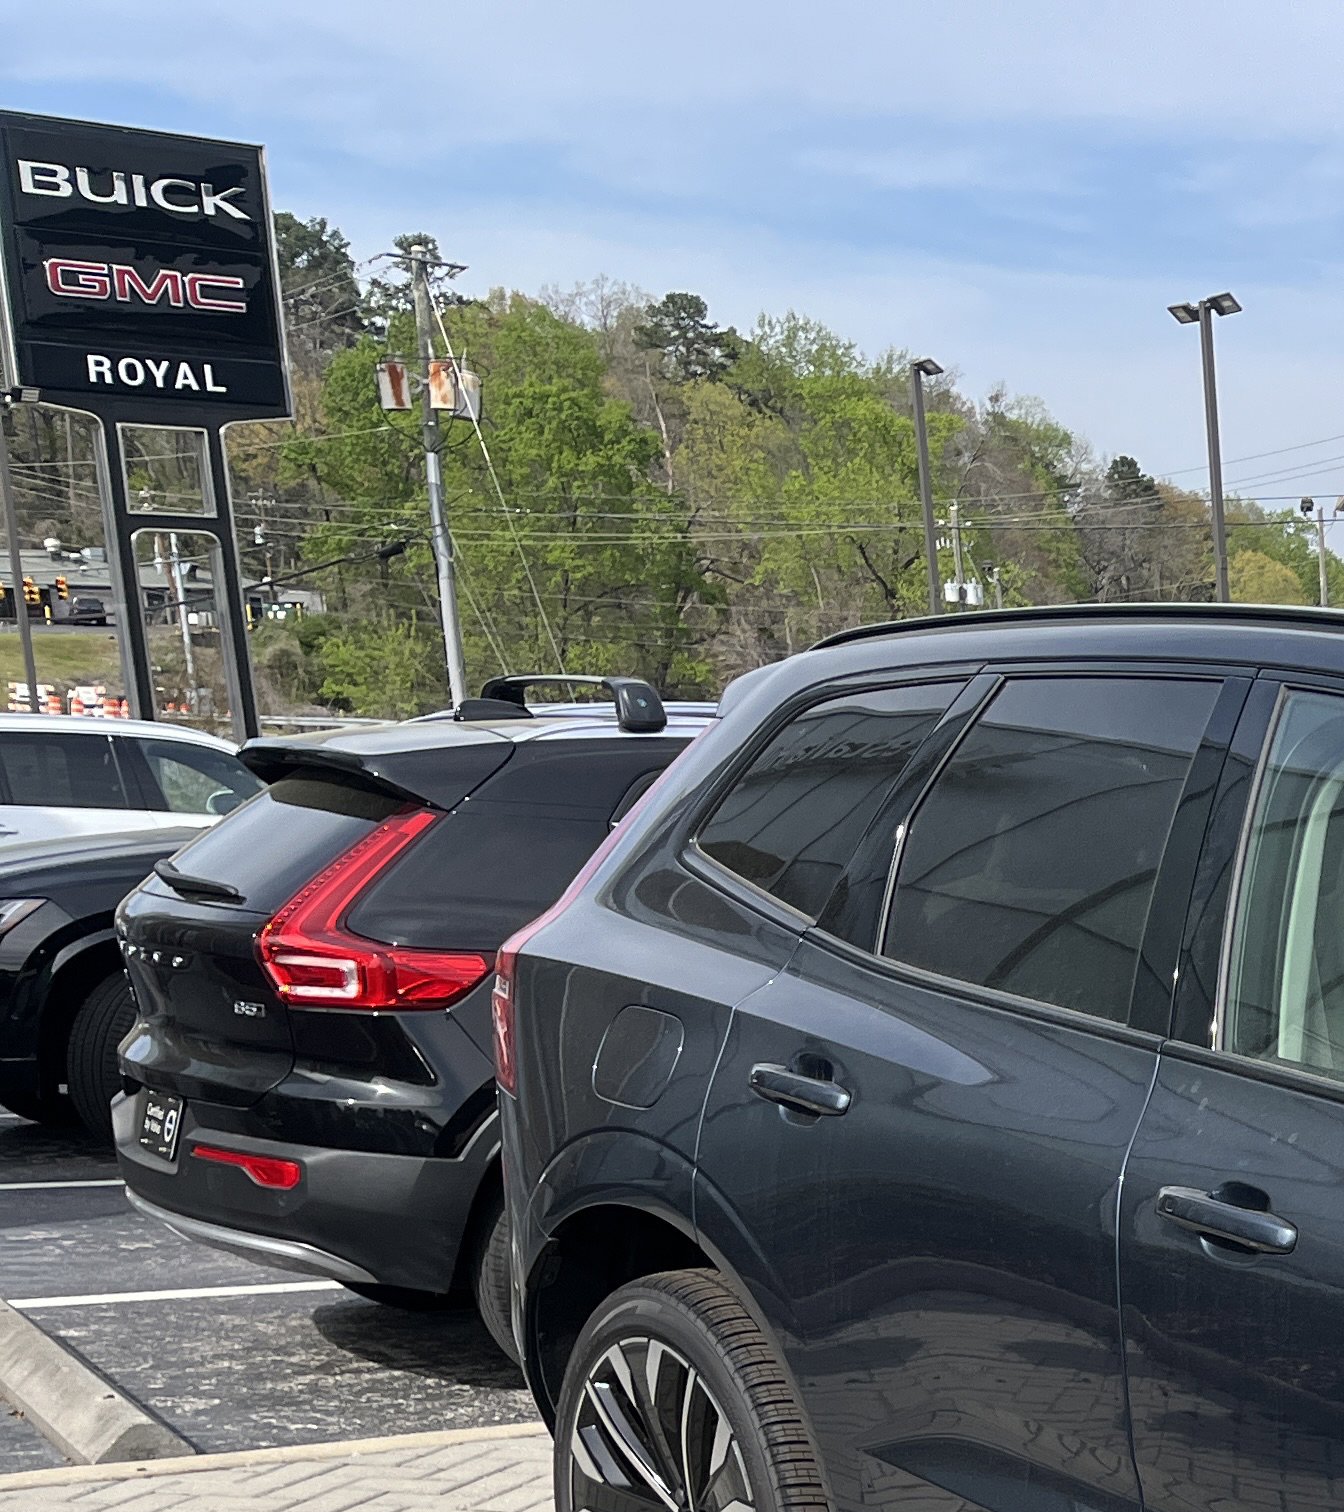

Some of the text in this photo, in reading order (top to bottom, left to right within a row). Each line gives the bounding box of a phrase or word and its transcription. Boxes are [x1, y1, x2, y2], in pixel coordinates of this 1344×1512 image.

[17, 158, 251, 220] BUICK
[43, 257, 247, 313] GMC
[86, 354, 227, 393] ROYAL
